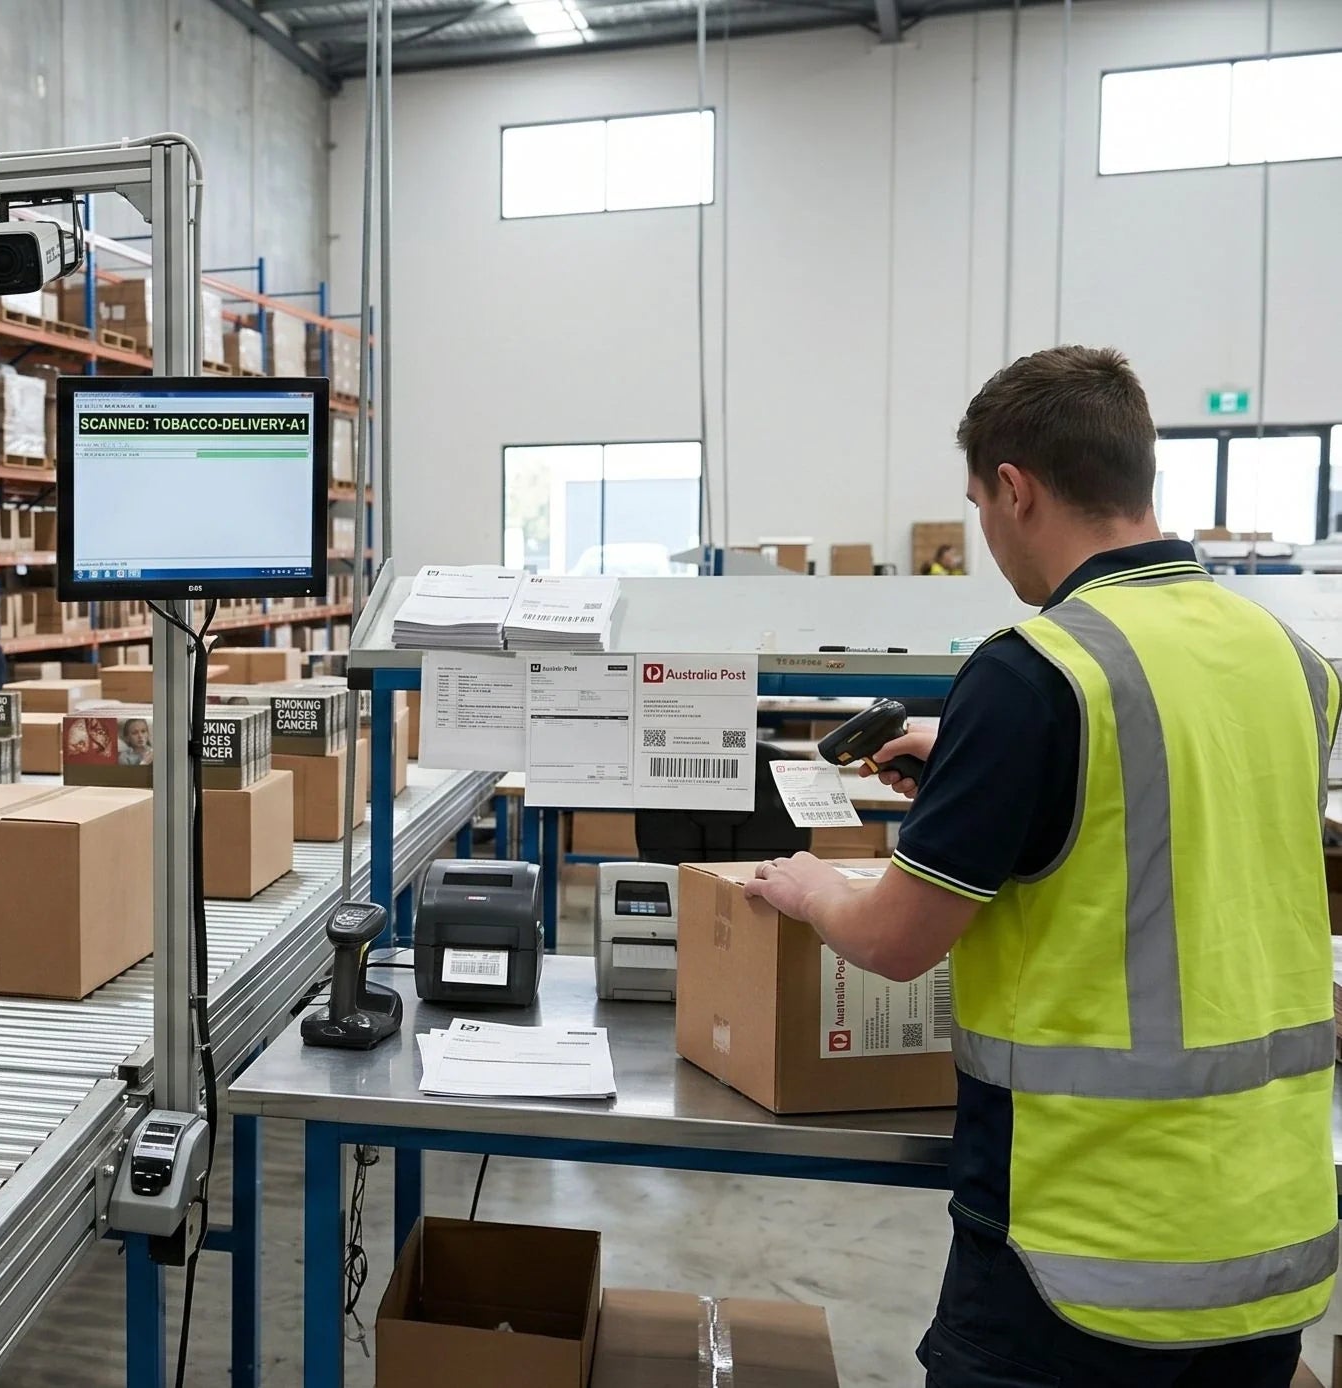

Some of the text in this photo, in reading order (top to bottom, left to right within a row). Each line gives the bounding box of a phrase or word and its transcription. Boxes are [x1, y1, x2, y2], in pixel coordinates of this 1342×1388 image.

[80, 418, 305, 431] SCANNED: TOBACCO-DELIVERY-A1
[665, 669, 746, 681] Australia Post
[275, 699, 321, 710] SMOKING
[277, 710, 317, 720] CAUSES
[276, 720, 318, 730] CANCER
[202, 735, 231, 746] USES
[202, 747, 233, 758] NCER
